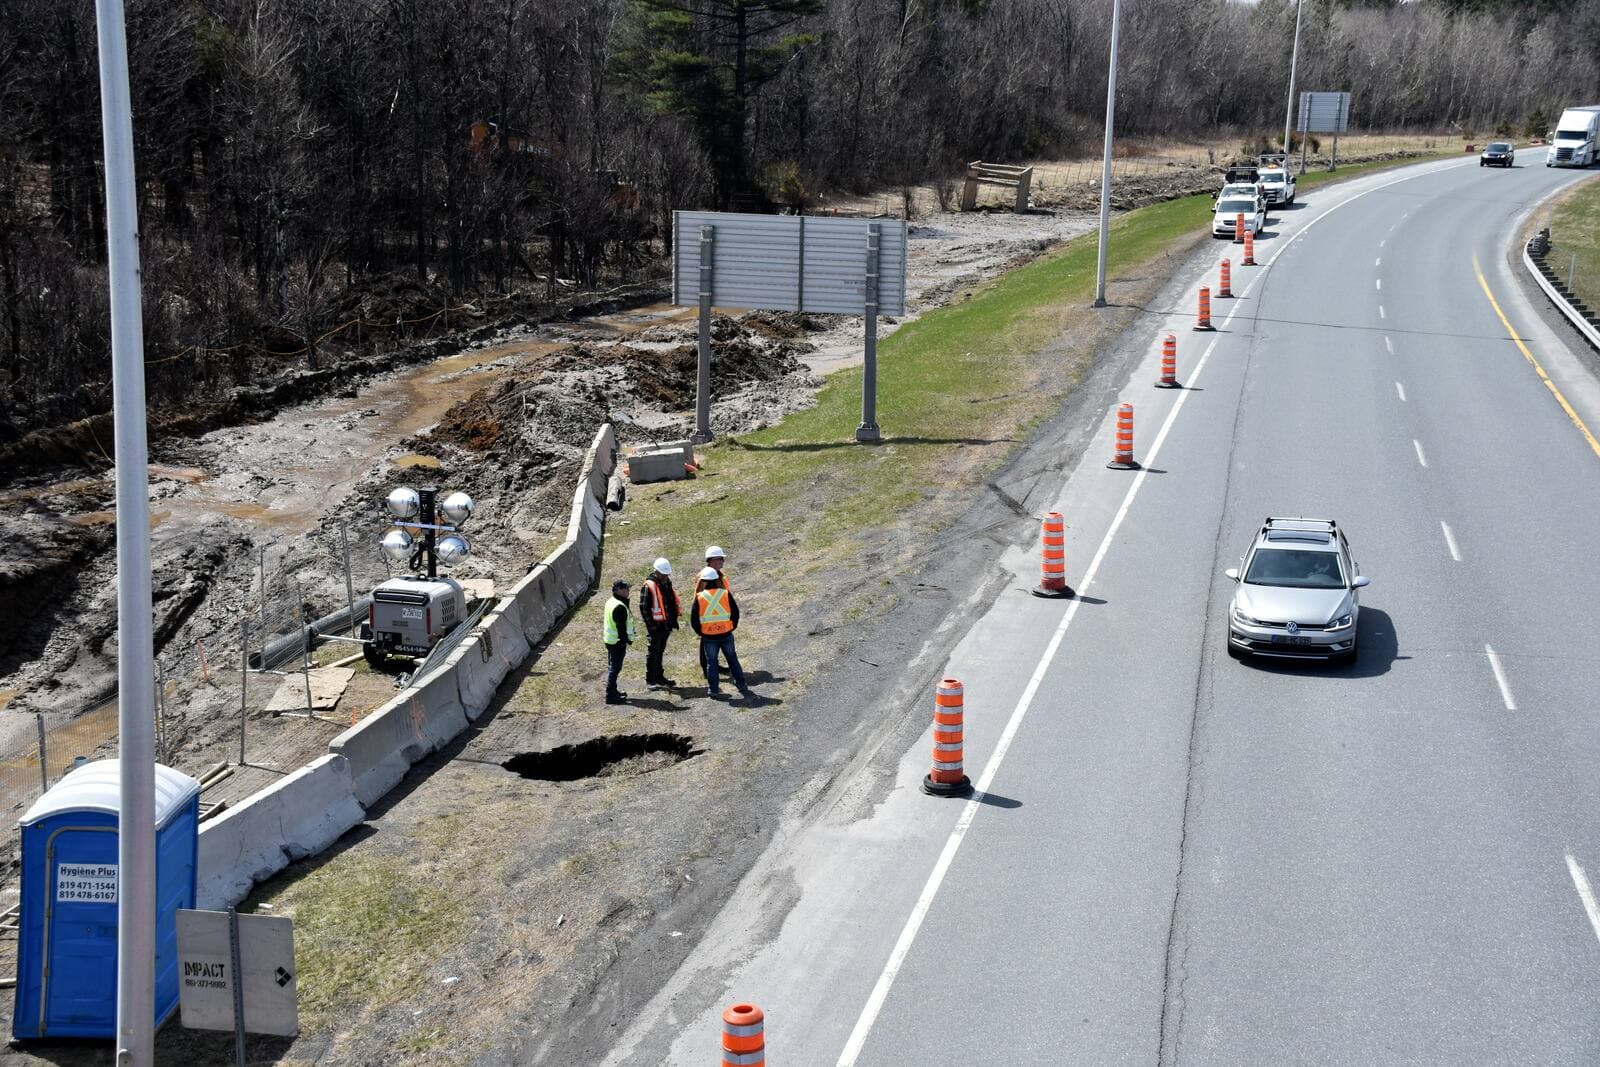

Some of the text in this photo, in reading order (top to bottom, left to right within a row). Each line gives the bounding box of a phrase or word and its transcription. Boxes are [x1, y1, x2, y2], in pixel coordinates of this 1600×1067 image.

[60, 866, 116, 877] Hygiène Plus
[60, 881, 116, 890] 819 471-1544
[59, 890, 116, 900] 819 478-6167
[184, 961, 225, 978] IMPACT
